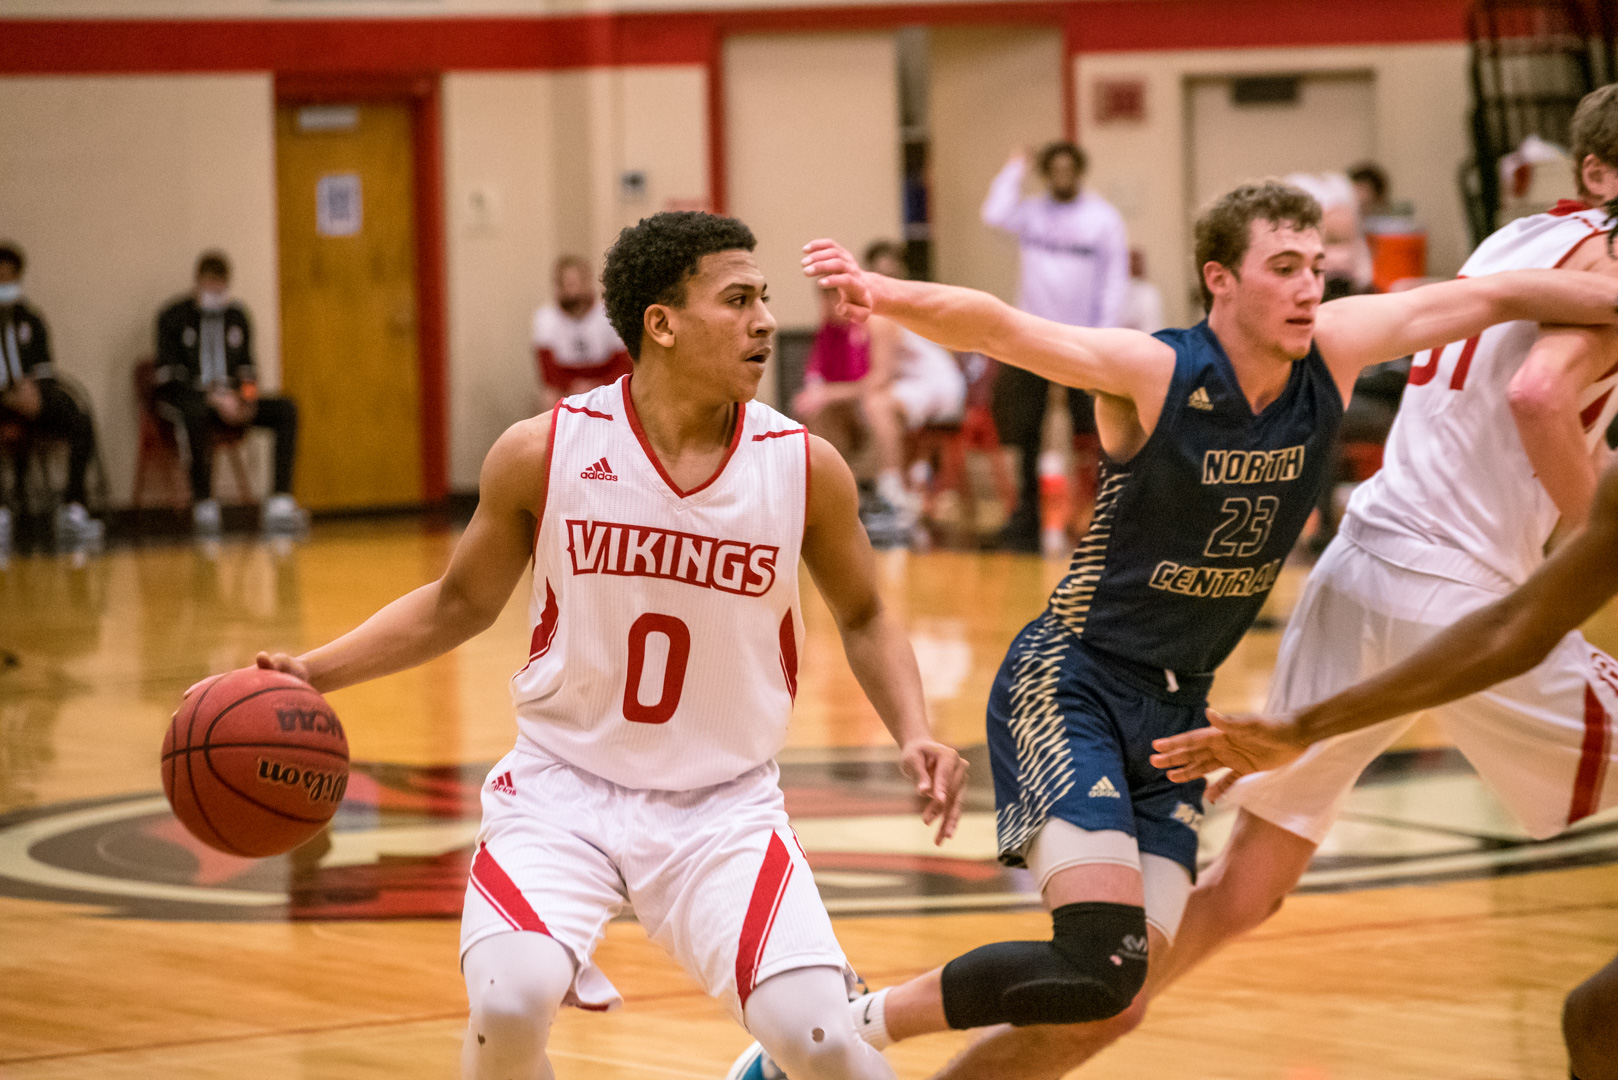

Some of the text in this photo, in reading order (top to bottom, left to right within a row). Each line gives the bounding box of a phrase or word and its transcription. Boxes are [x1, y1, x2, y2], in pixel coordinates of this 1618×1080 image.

[580, 470, 619, 482] adidas
[1201, 445, 1305, 484] NORTH
[1203, 495, 1280, 557] 23
[565, 519, 780, 598] VIKINGS
[622, 612, 691, 725] 0
